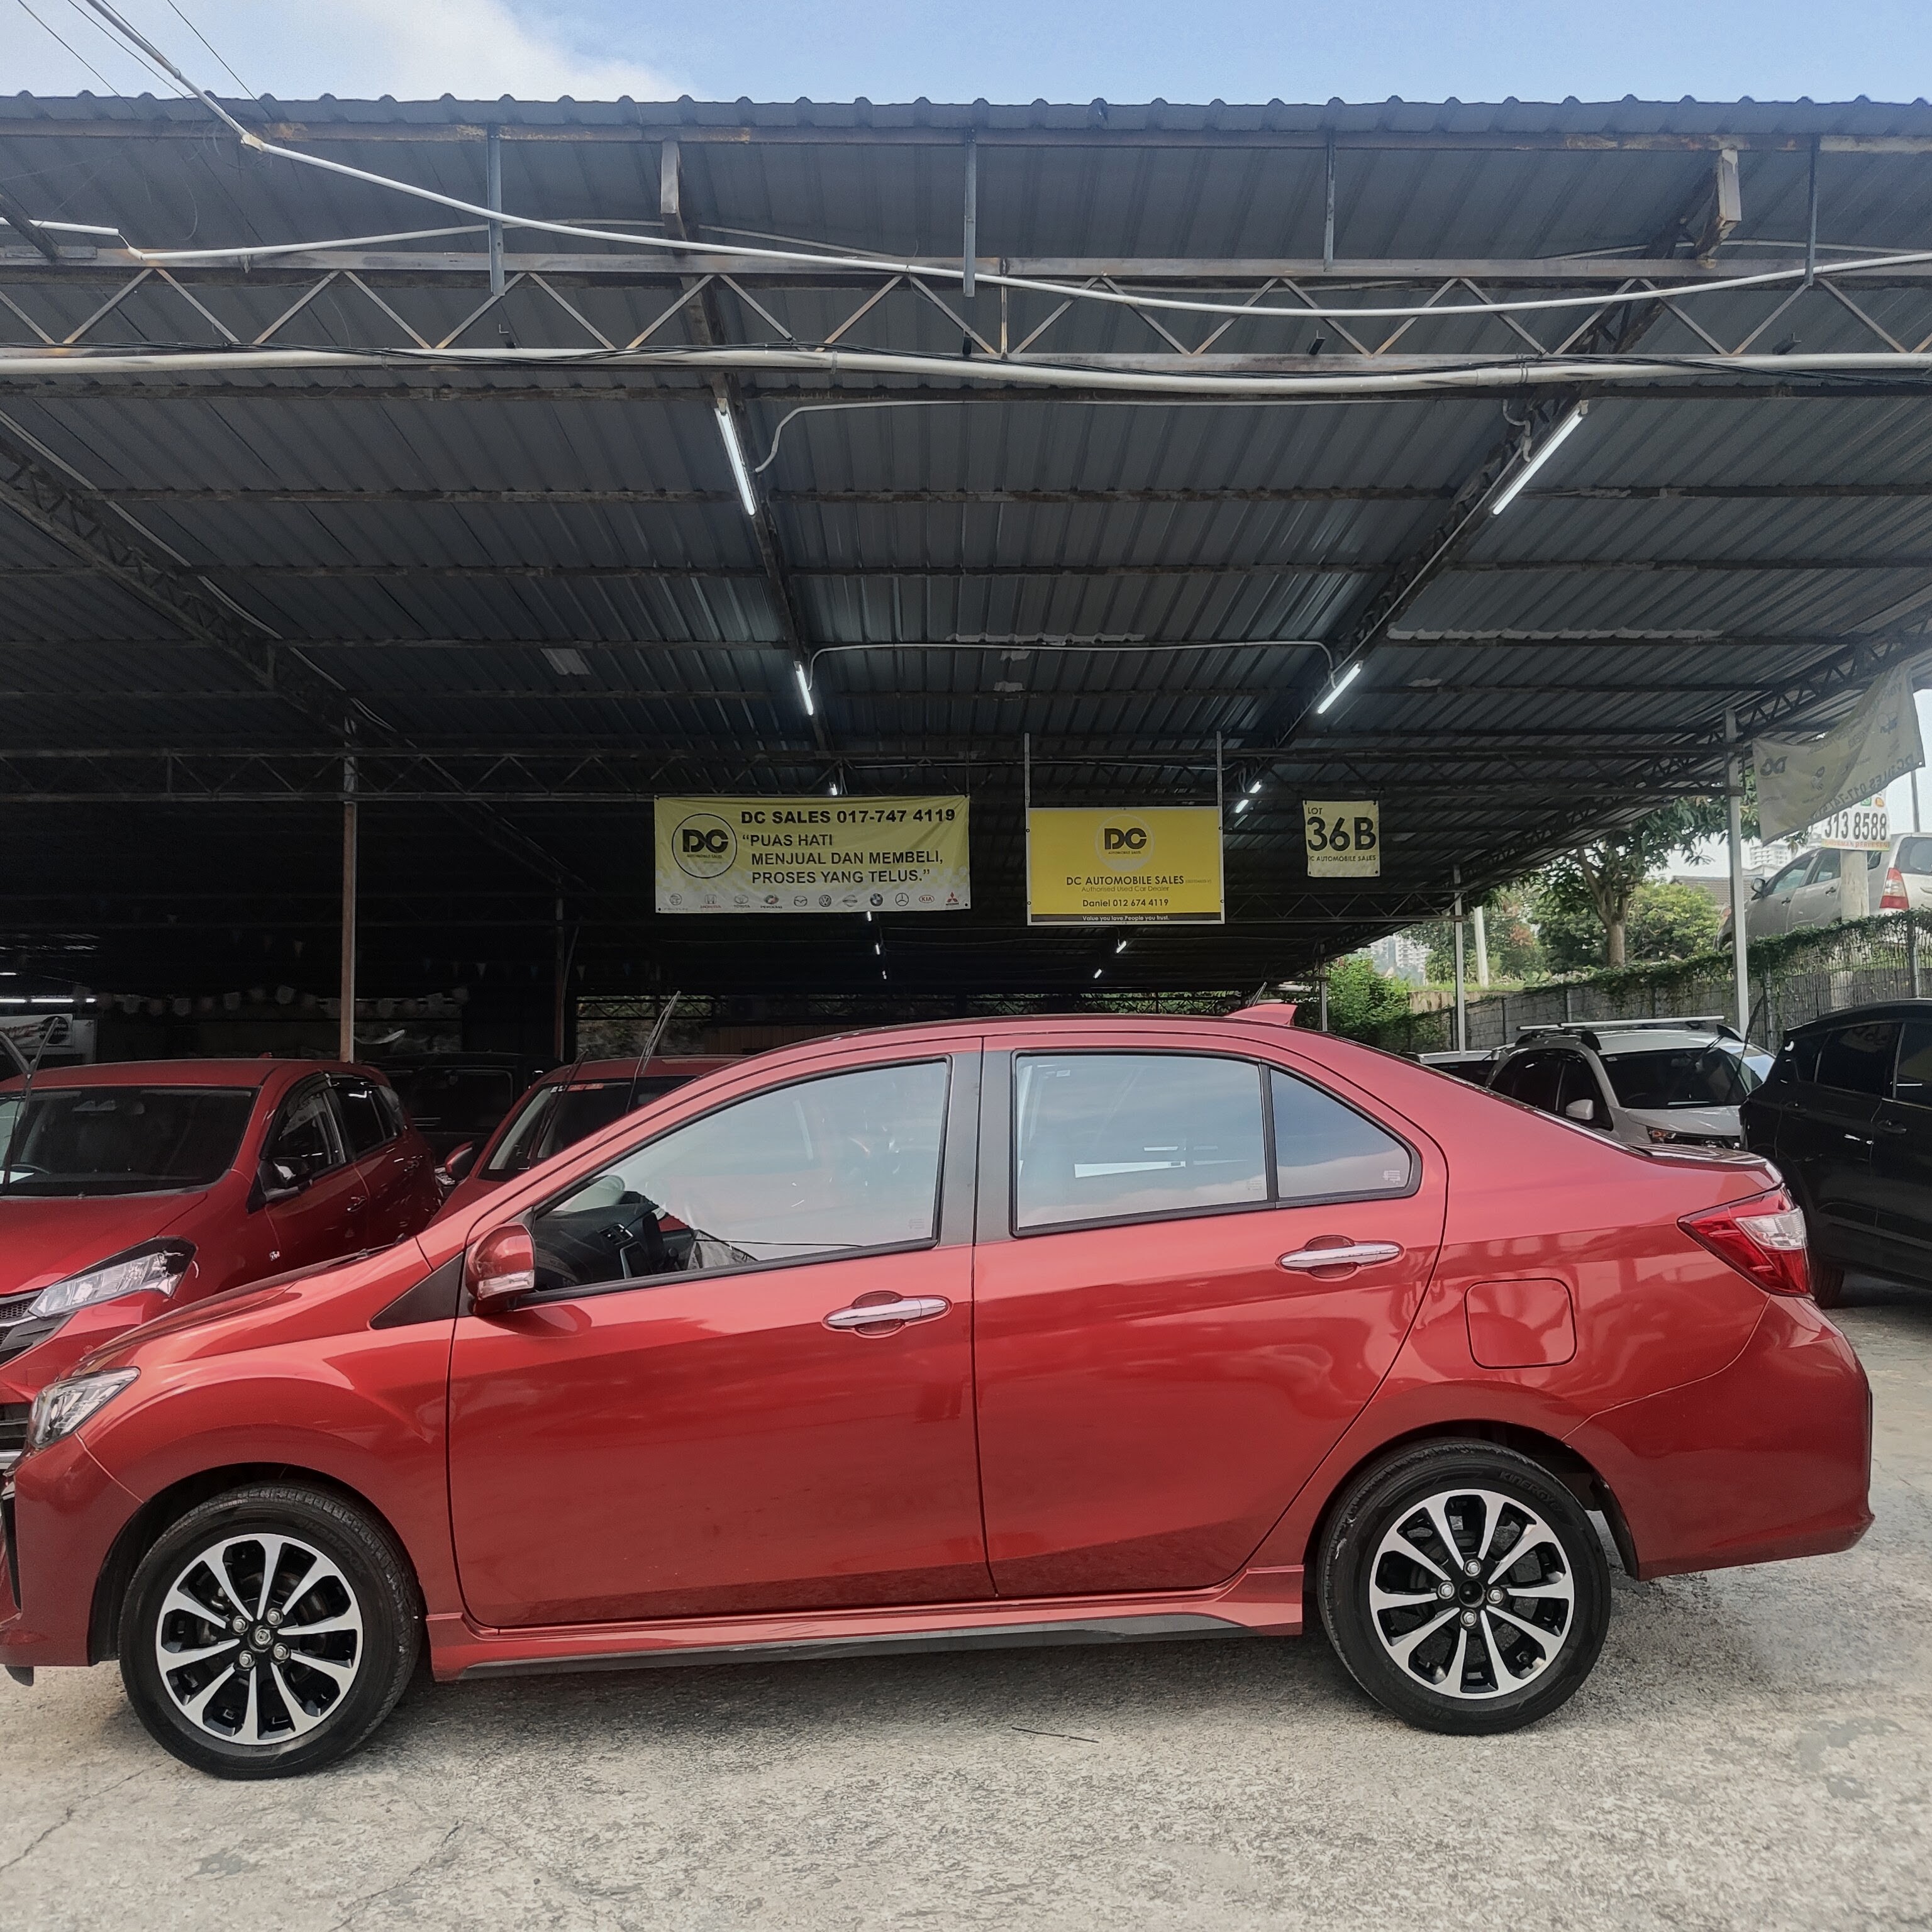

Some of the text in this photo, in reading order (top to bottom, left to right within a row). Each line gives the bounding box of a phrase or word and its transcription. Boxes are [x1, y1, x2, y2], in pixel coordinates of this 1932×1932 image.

[741, 808, 955, 825] DC SALES 017-747 4119
[1307, 807, 1323, 815] LOT
[1307, 816, 1376, 852] 36B
[1853, 812, 1887, 841] 8588
[682, 829, 728, 853] DC
[798, 834, 833, 847] HATI
[1104, 827, 1147, 850] DC
[751, 850, 943, 865] MENJUAL DAN MEMBELI,
[752, 870, 816, 884] PROSES
[820, 870, 863, 884] YANG
[1066, 877, 1082, 886] DC
[1085, 875, 1152, 886] AUTOMOBILE
[1155, 875, 1184, 885] SALES
